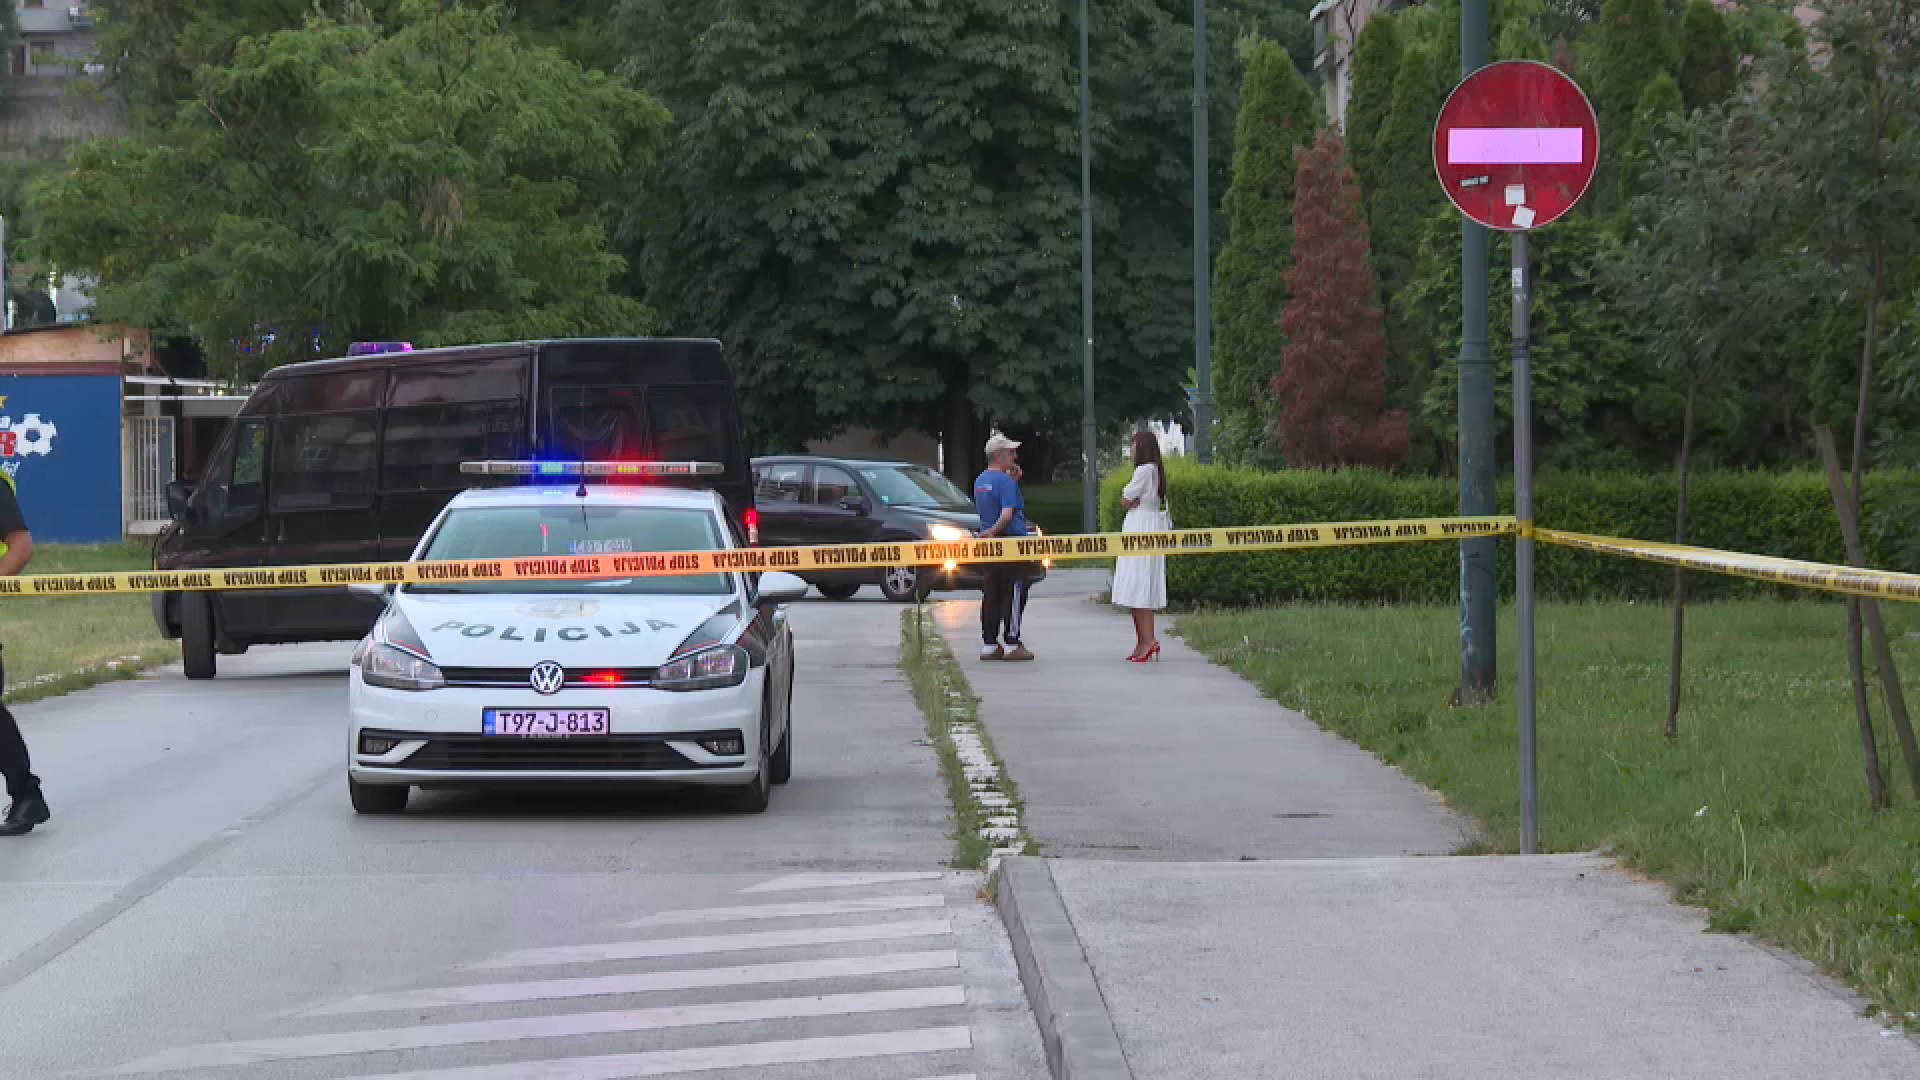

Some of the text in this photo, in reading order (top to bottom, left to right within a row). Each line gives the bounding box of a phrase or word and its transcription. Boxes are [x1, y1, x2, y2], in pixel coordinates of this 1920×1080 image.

[1182, 530, 1212, 547] STOP
[1226, 528, 1284, 545] POLICIJA
[1288, 526, 1318, 543] STOP
[1332, 524, 1390, 541] POLICIJA
[1396, 523, 1426, 539] STOP
[972, 541, 1002, 558] STOP
[1018, 538, 1072, 556] POLICIJA
[1076, 536, 1108, 553] STOP
[1122, 532, 1176, 551] POLICIJA
[770, 550, 798, 567] STOP
[812, 547, 866, 565] POLICIJA
[870, 545, 900, 562] STOP
[914, 542, 968, 560] POLICIJA
[514, 559, 566, 576] POLICIJA
[570, 557, 600, 574] STOP
[614, 555, 666, 572] POLICIJA
[670, 554, 698, 570] STOP
[712, 551, 766, 569] POLICIJA
[277, 569, 308, 586] STOP
[320, 567, 372, 584] POLICIJA
[376, 566, 404, 582] STOP
[418, 562, 468, 580] POLICIJA
[472, 561, 502, 578] STOP
[0, 579, 21, 595] STO
[33, 577, 85, 594] POLICIJA
[87, 576, 116, 592] STOP
[128, 573, 181, 591] POLICIJA
[182, 572, 212, 589] STOP
[223, 570, 275, 588] POLICIJA
[431, 615, 680, 643] POLICIJA
[498, 711, 605, 733] T97-J-813
